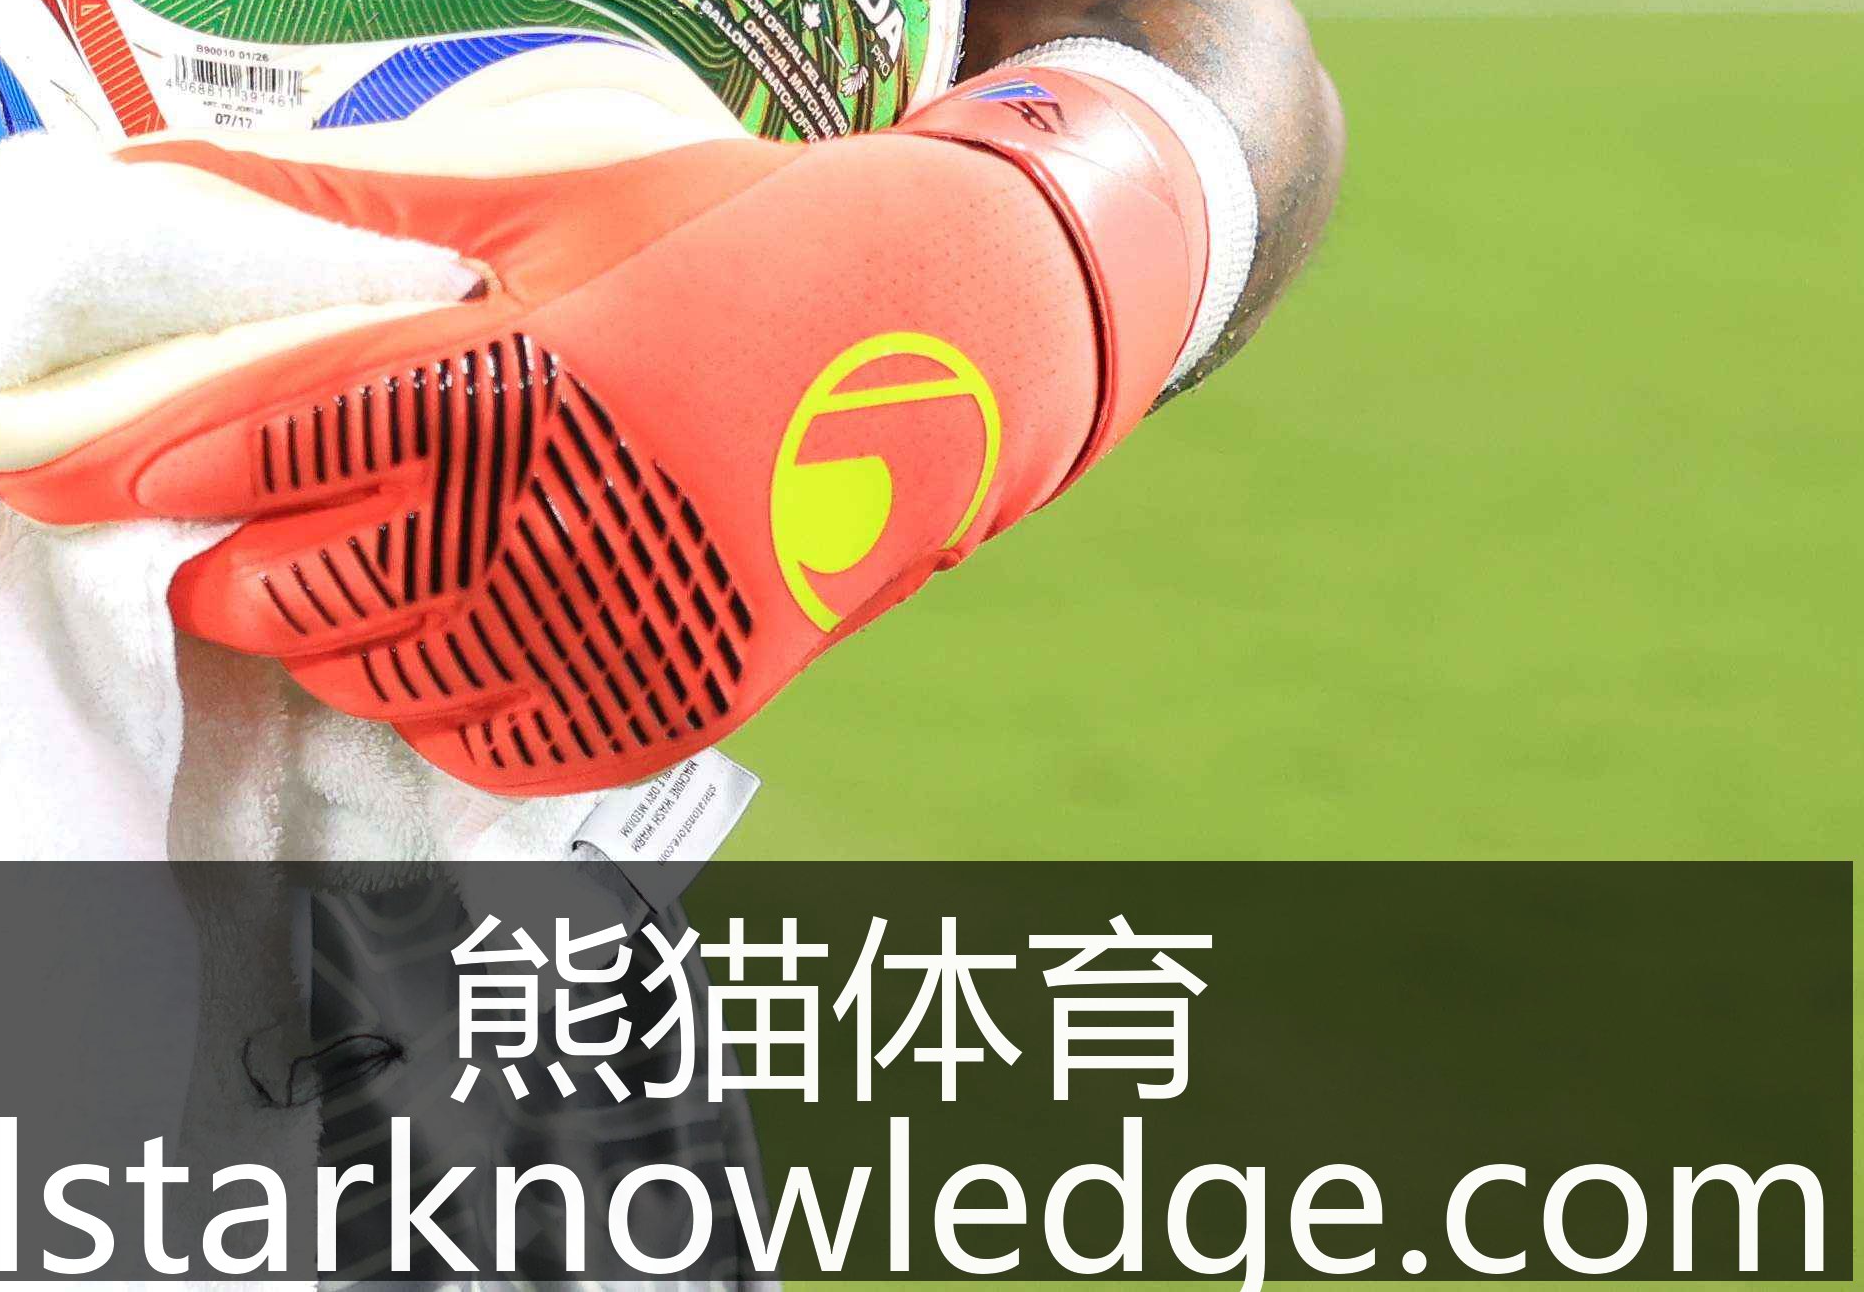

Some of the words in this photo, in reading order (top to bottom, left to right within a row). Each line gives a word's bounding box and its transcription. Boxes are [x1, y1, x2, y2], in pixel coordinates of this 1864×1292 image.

[700, 0, 752, 58] BALLON
[748, 51, 764, 71] DE
[762, 67, 799, 114] MATCH
[743, 19, 791, 79] OFFICIAL
[787, 73, 824, 121] MATCH
[764, 15, 803, 66] OFICIAL
[801, 59, 819, 89] DEL
[817, 82, 849, 136] PARTIDO
[871, 44, 891, 77] PRO
[652, 797, 676, 826] WASH
